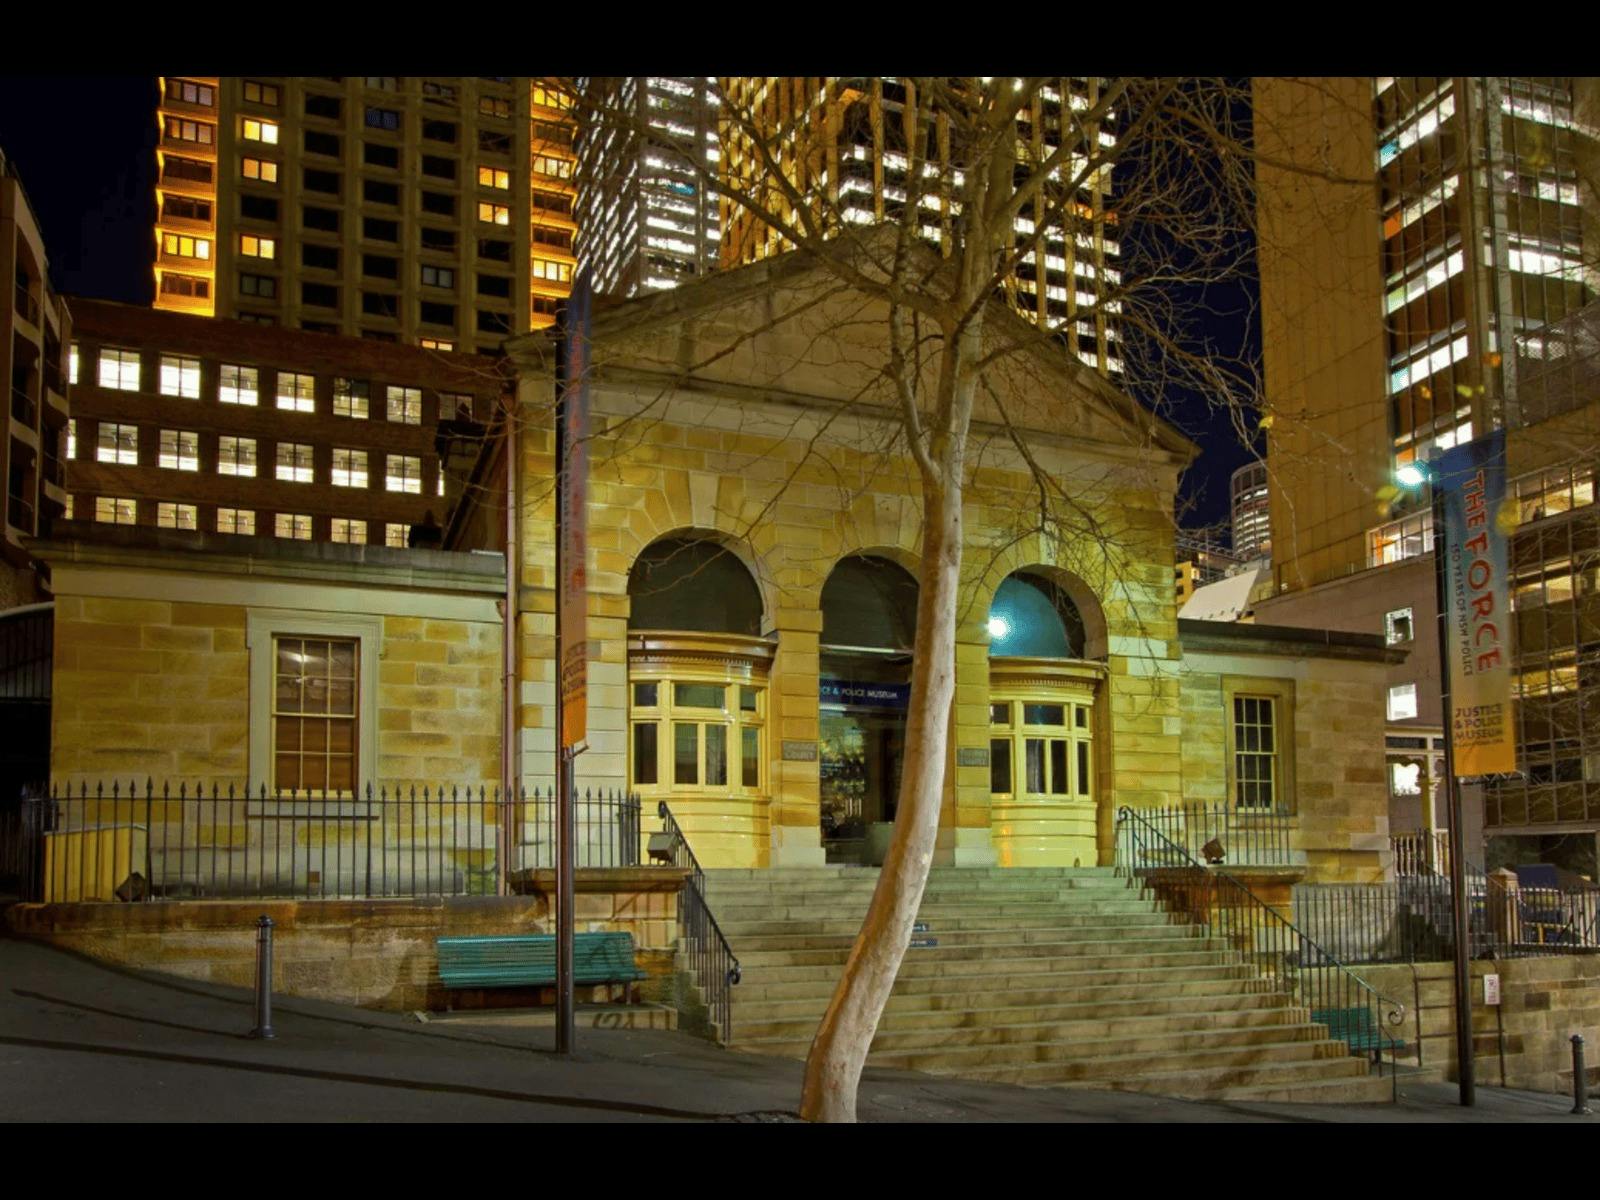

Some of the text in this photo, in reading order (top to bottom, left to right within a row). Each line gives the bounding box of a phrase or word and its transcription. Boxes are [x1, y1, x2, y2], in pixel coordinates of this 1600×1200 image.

[1453, 564, 1466, 597] YEARS
[1462, 470, 1502, 672] THE FORCE
[1456, 598, 1467, 612] OF
[1459, 613, 1469, 637] NSW
[1461, 639, 1474, 677] POLICE
[842, 688, 865, 697] POLICE
[867, 690, 898, 698] MUSEUM
[1455, 703, 1503, 718] JUSTICE
[1464, 715, 1503, 728] POLICE
